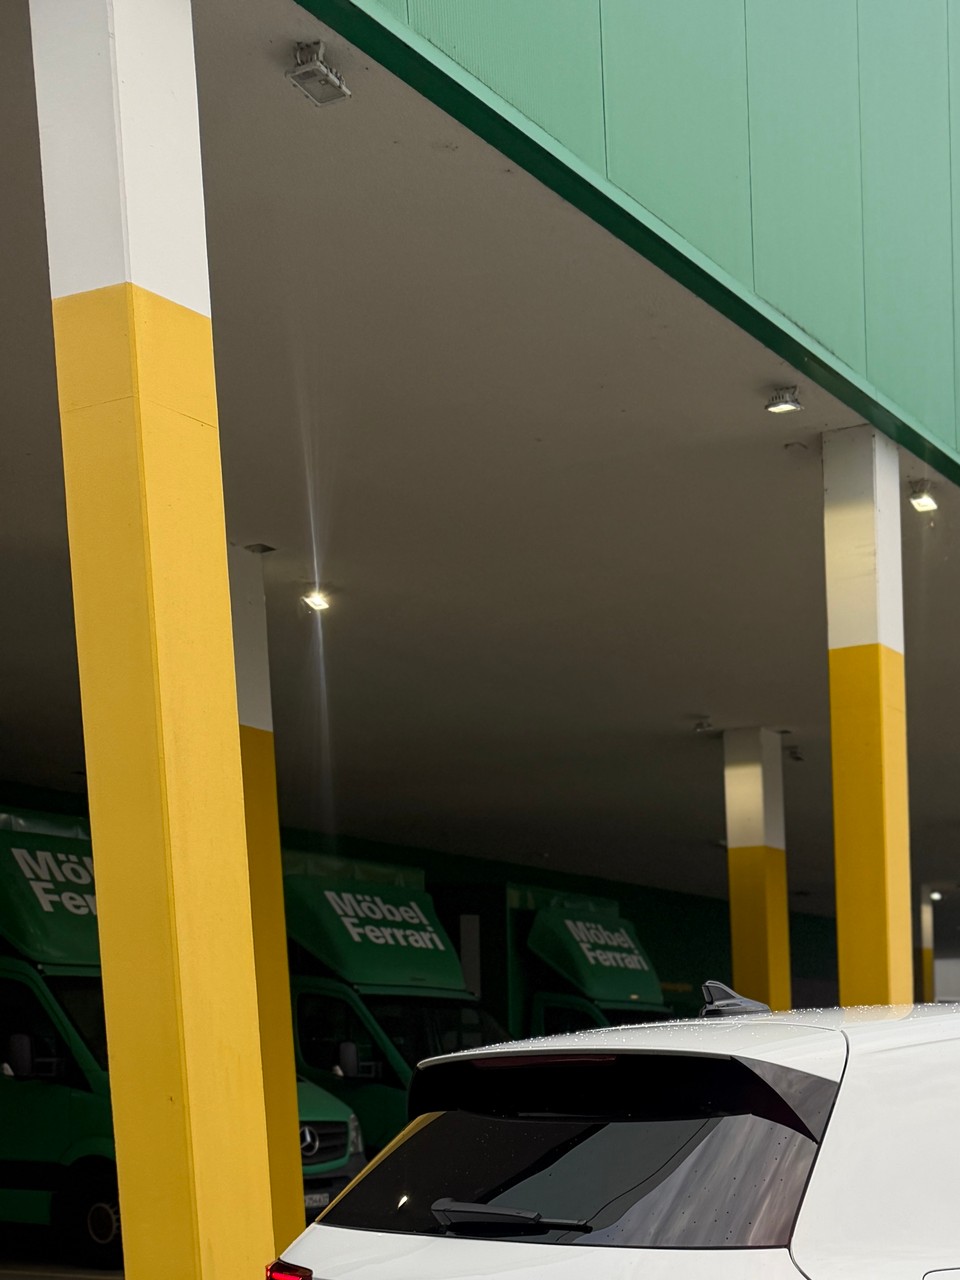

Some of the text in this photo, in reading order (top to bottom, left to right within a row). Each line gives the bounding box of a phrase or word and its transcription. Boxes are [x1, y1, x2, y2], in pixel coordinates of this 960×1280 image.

[324, 891, 429, 925] Möbel
[341, 916, 446, 951] Ferrari
[564, 920, 636, 949] Möbel
[579, 942, 649, 971] Ferrari
